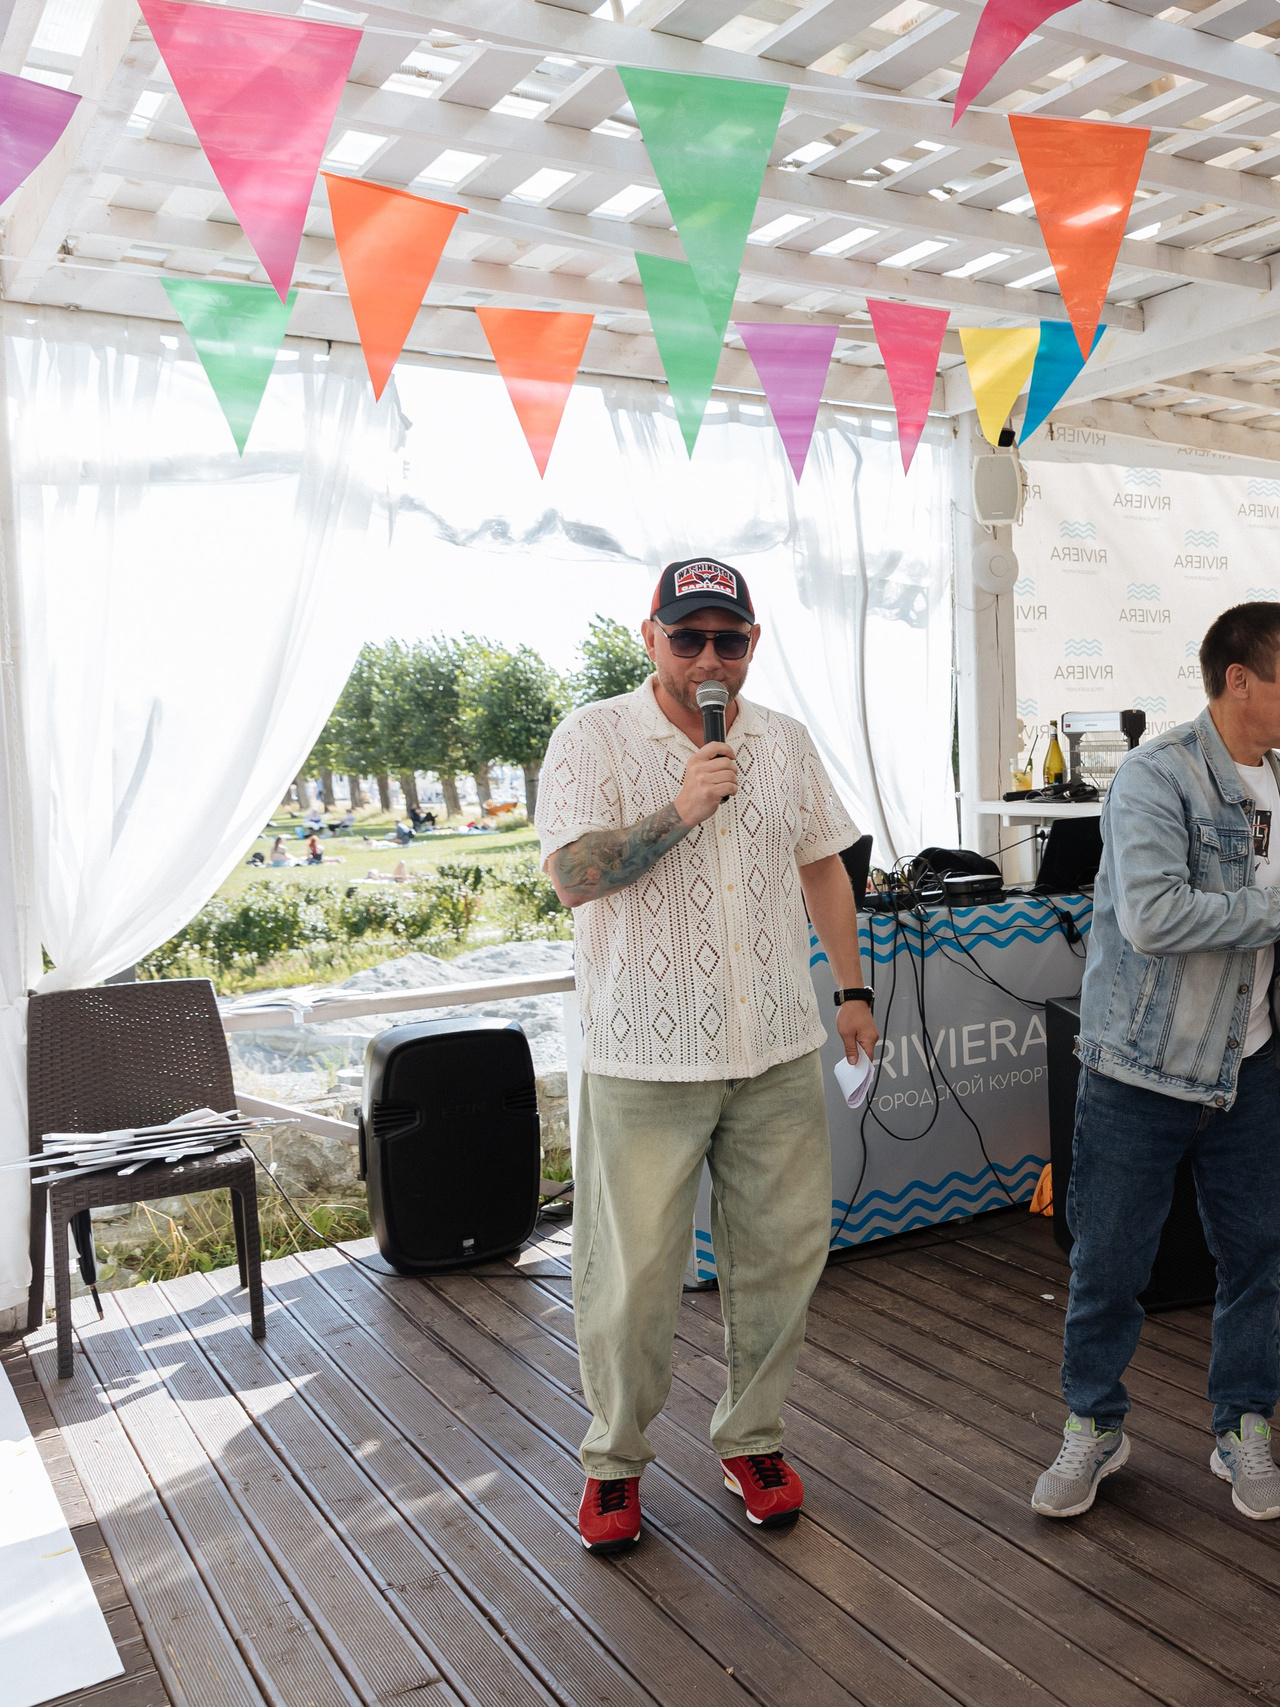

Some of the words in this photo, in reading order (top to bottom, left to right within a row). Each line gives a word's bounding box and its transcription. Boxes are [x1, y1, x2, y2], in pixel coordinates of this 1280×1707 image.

[678, 564, 734, 581] WASHINGTON
[682, 584, 732, 593] CAPITALS
[872, 1014, 1047, 1079] RIVIERA
[989, 1065, 1048, 1091] КУРОРТ
